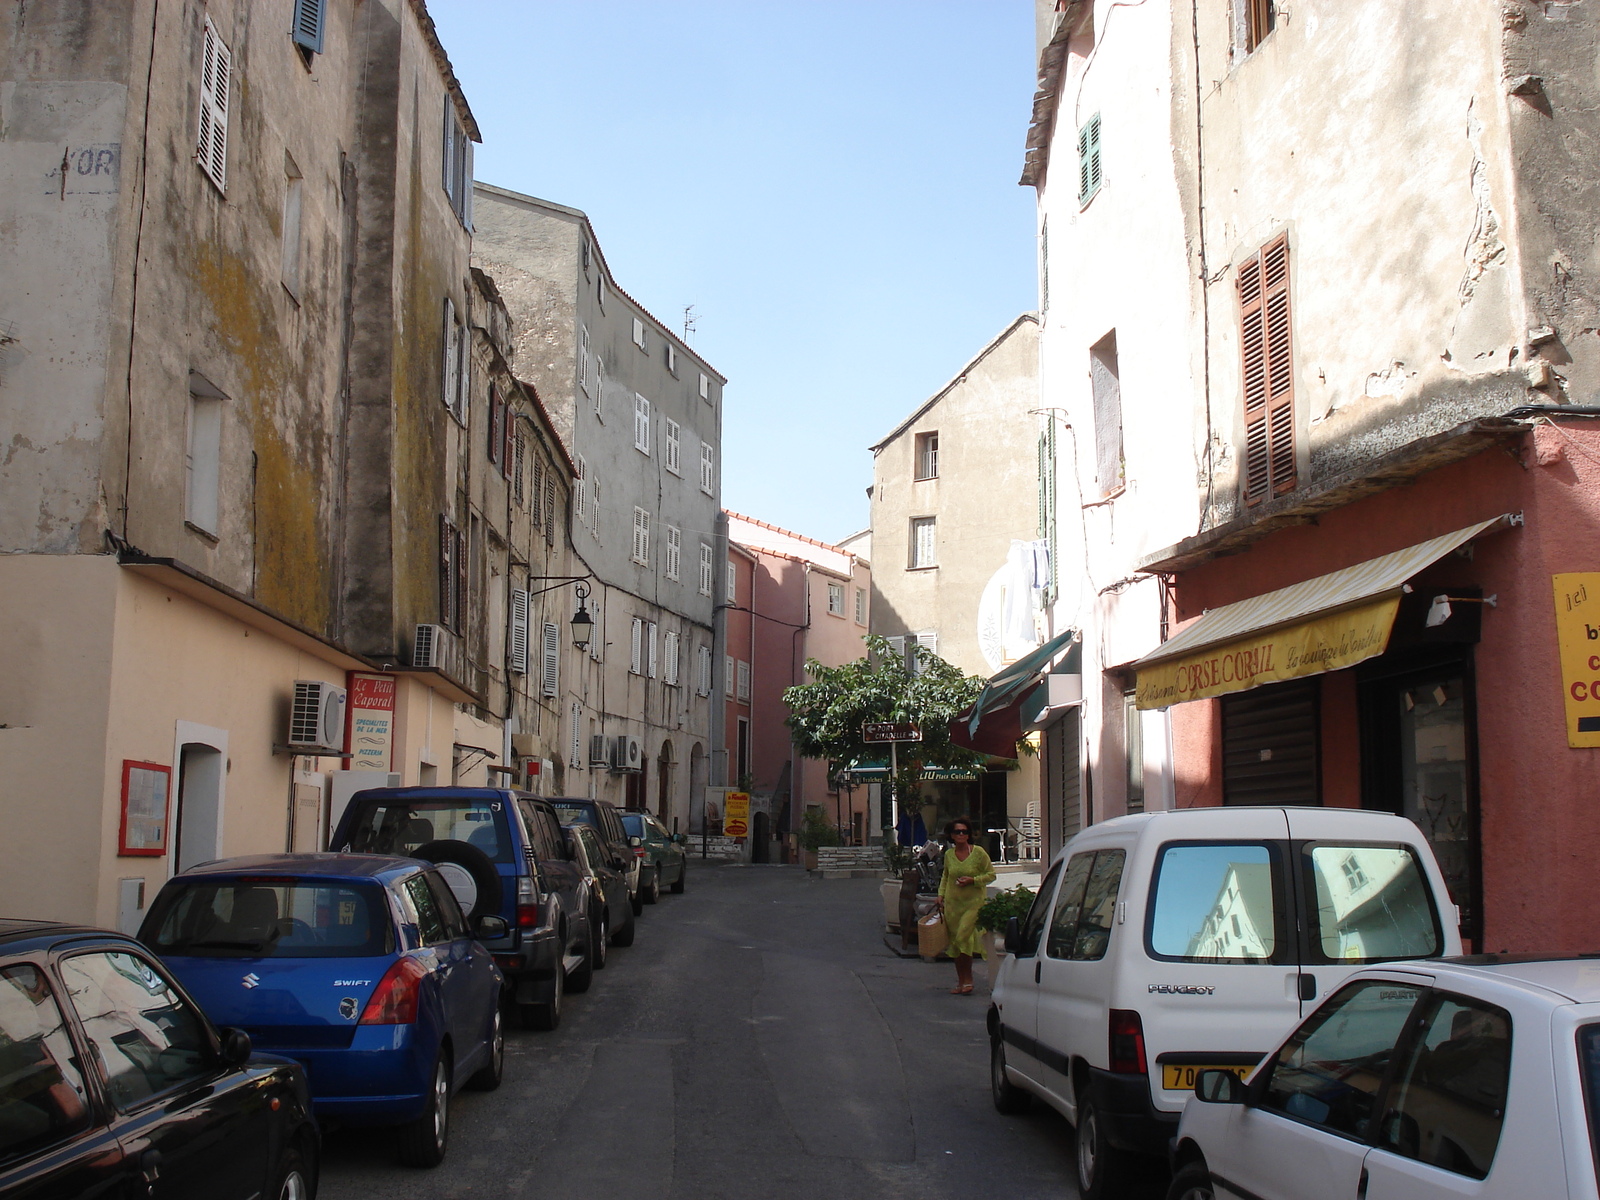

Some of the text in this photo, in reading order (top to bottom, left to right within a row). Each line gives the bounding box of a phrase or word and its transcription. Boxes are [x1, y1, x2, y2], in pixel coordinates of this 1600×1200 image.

[1565, 584, 1587, 612] ici
[1178, 653, 1220, 694] CORSE
[1222, 644, 1275, 684] CORAIL
[354, 679, 393, 694] Le Petit
[354, 692, 393, 708] Caporal
[875, 731, 907, 740] CITADELLE
[358, 748, 383, 756] PIZZERIA
[1148, 984, 1216, 996] PEUGEOT
[1380, 990, 1419, 1000] PART
